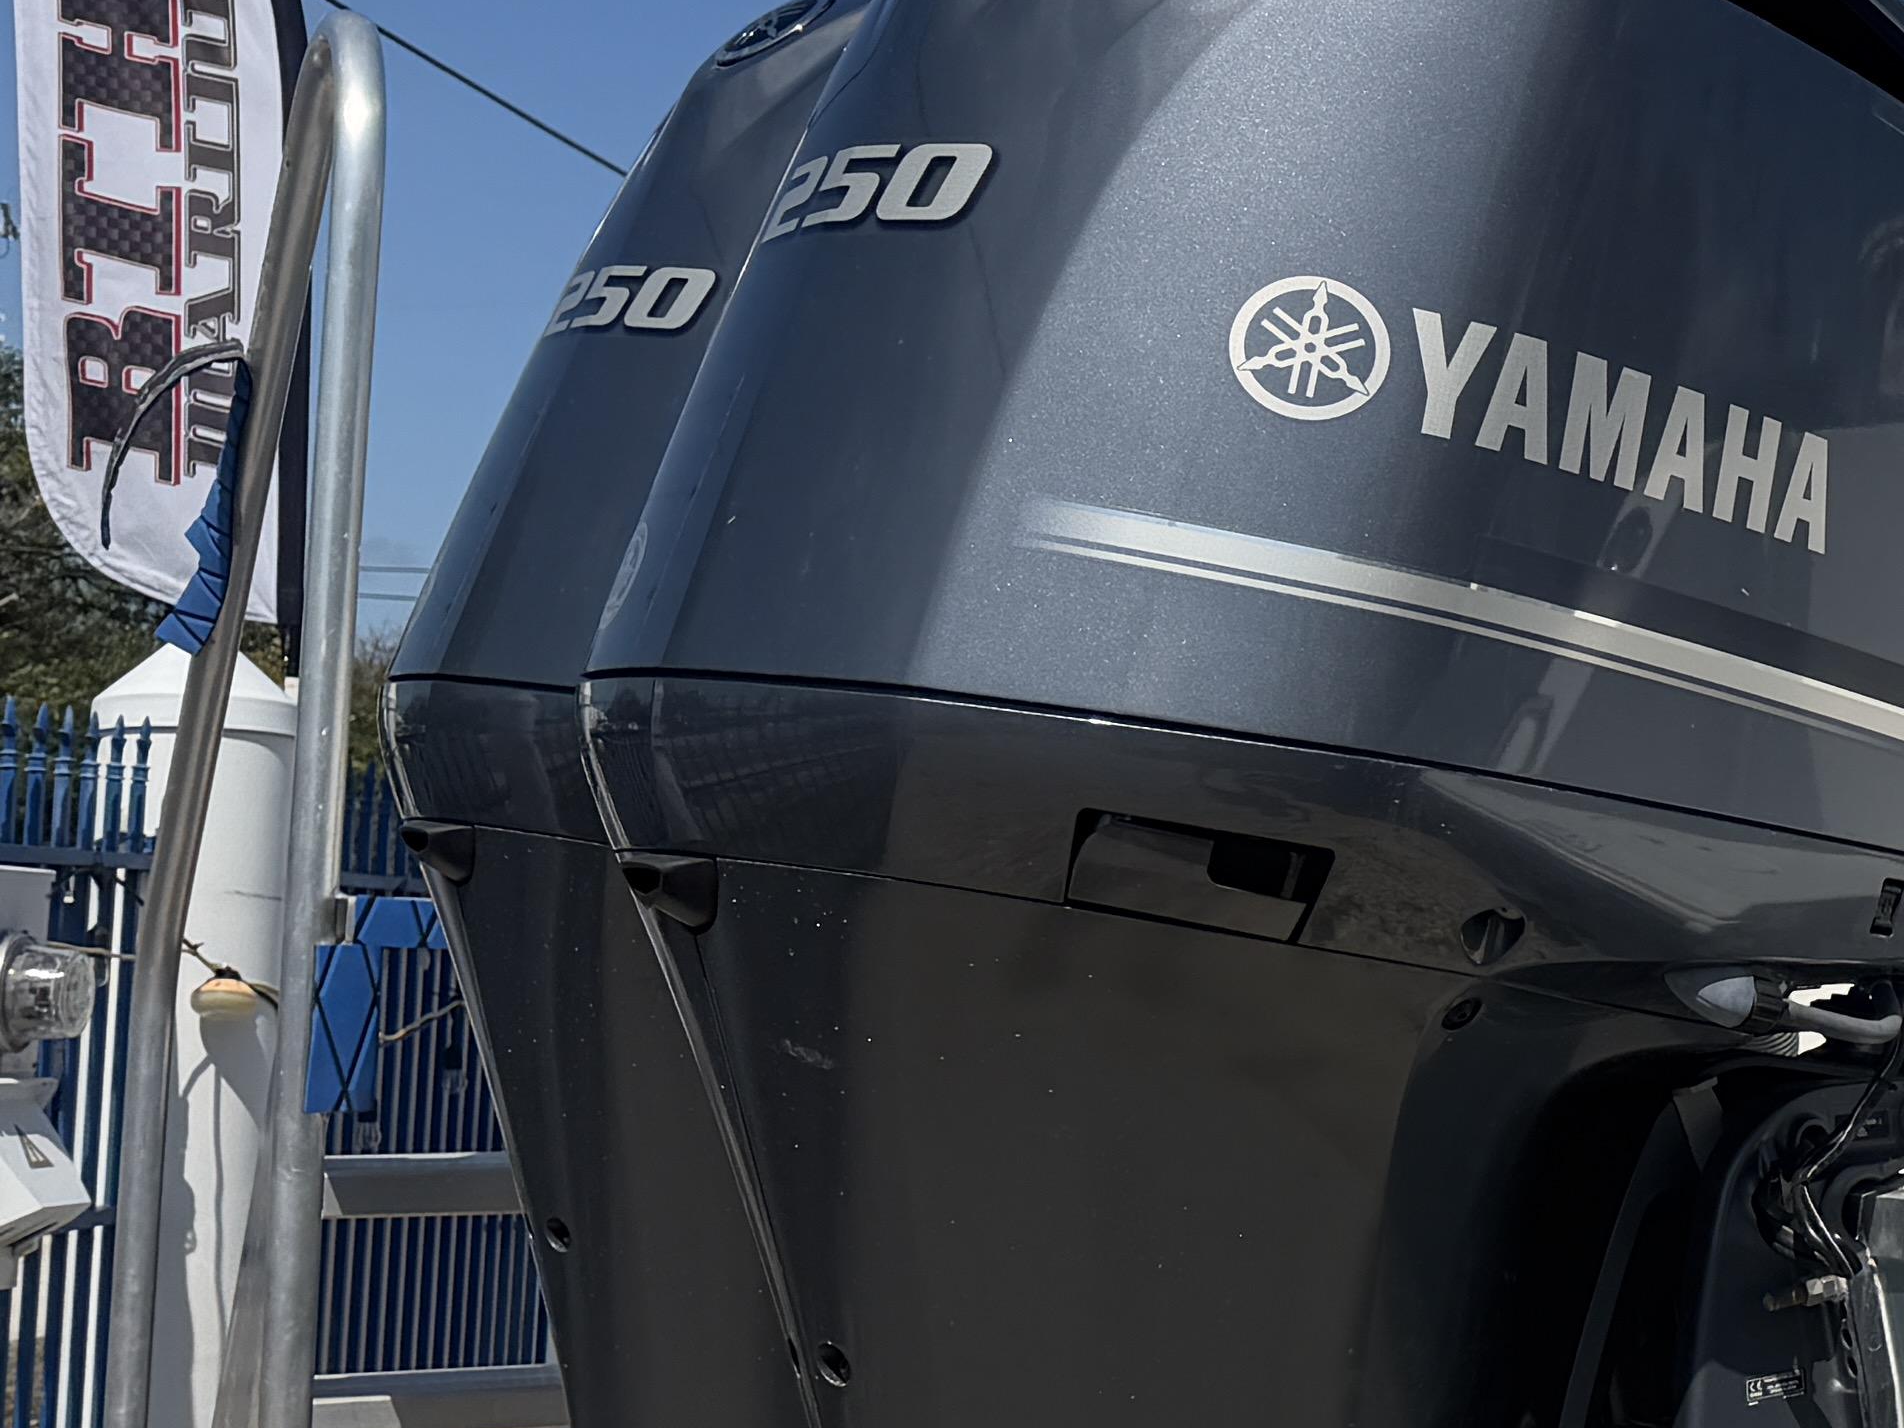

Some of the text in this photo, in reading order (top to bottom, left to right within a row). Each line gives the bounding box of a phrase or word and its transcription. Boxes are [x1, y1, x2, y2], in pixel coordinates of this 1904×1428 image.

[760, 143, 994, 245] 250
[543, 264, 716, 338] 250
[1412, 307, 1830, 556] YAMAHA
